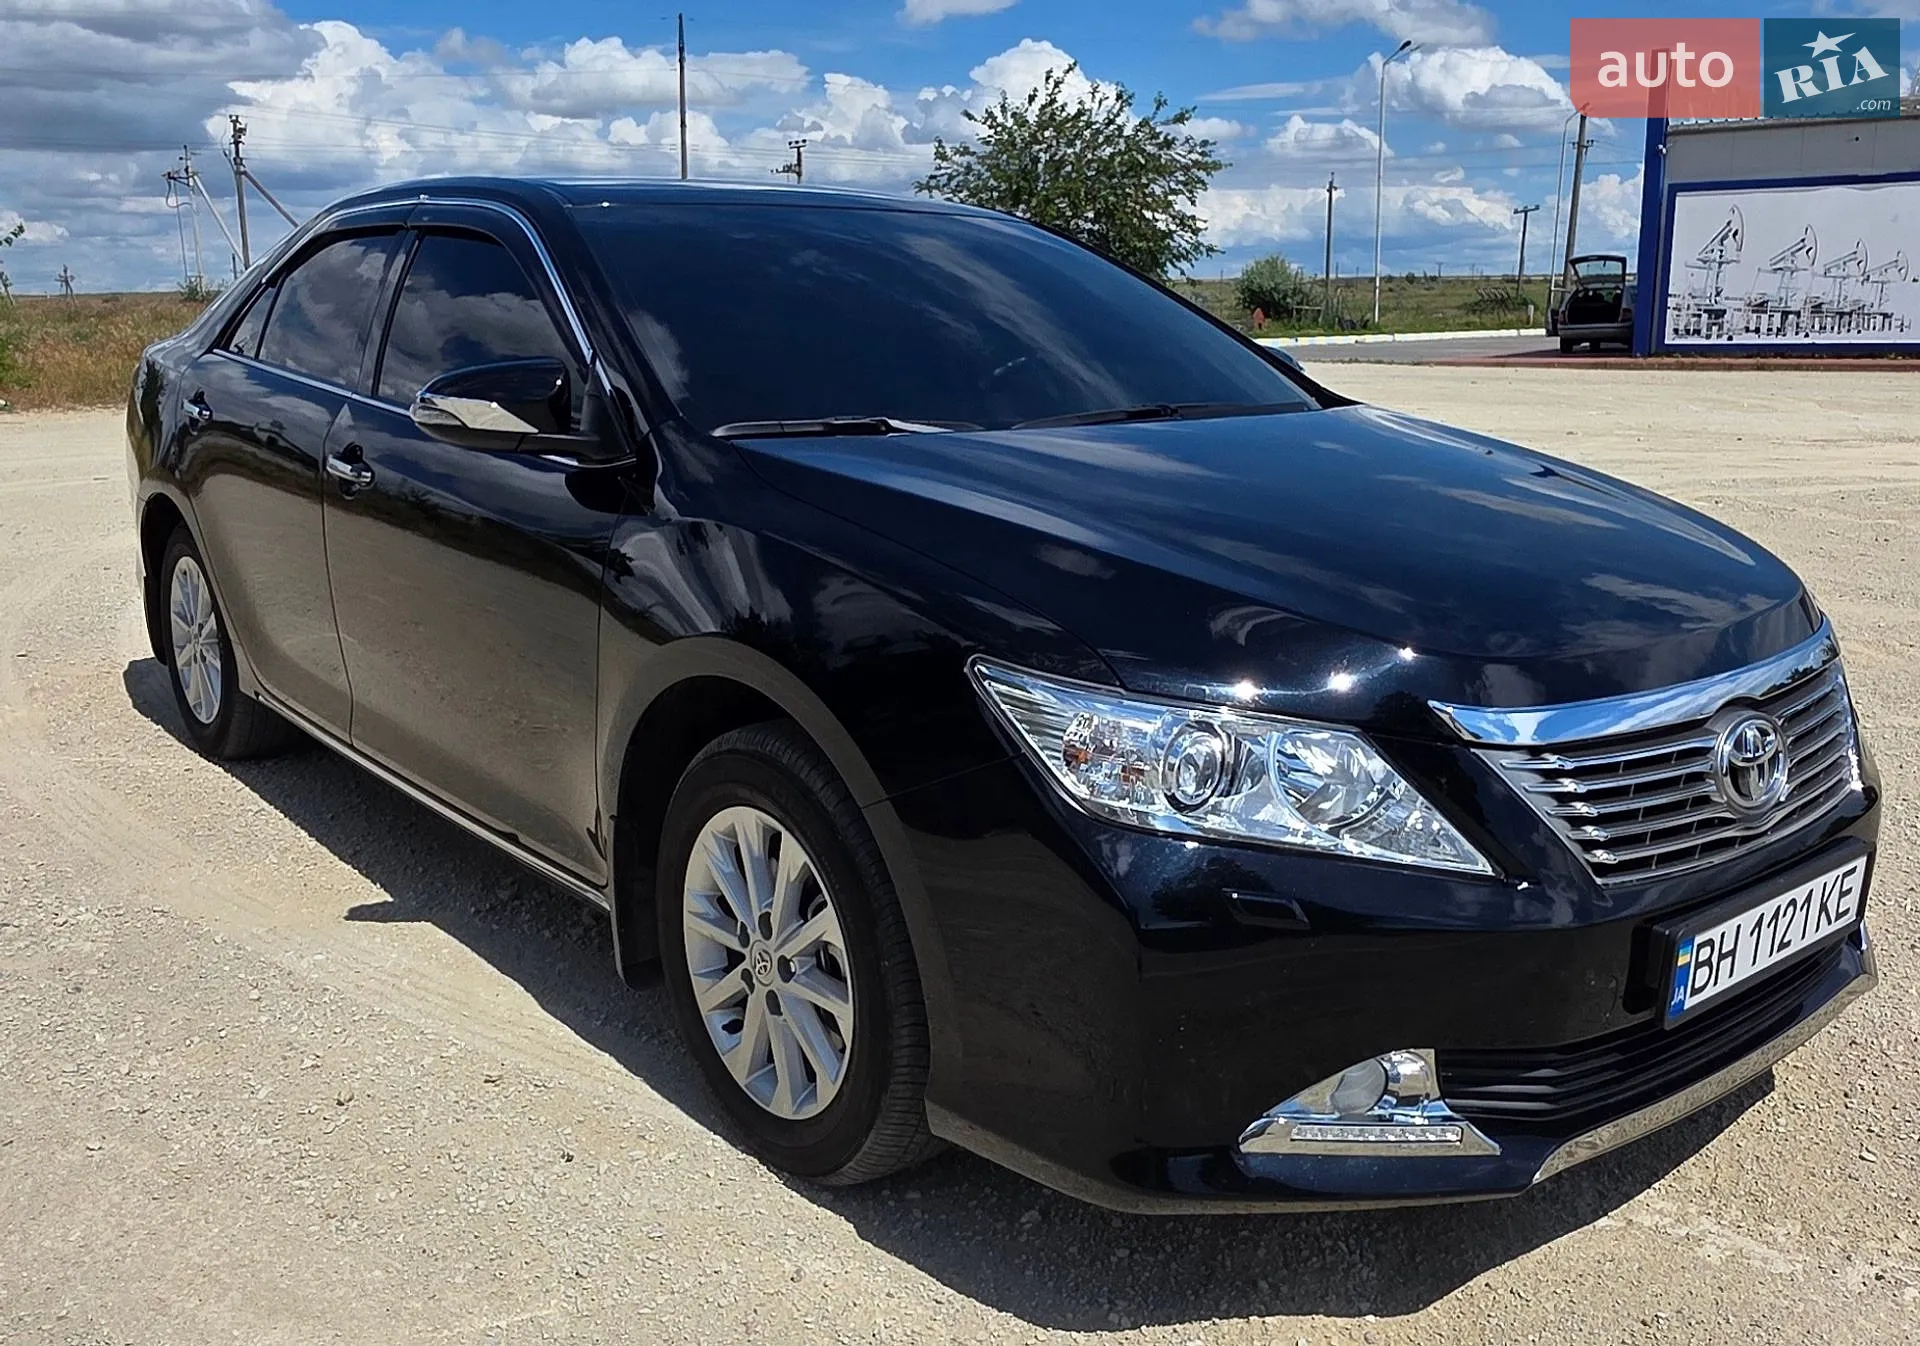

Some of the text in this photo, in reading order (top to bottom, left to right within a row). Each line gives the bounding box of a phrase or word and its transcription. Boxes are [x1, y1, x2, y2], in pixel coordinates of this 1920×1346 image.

[1688, 865, 1858, 998] BH 1121 KE
